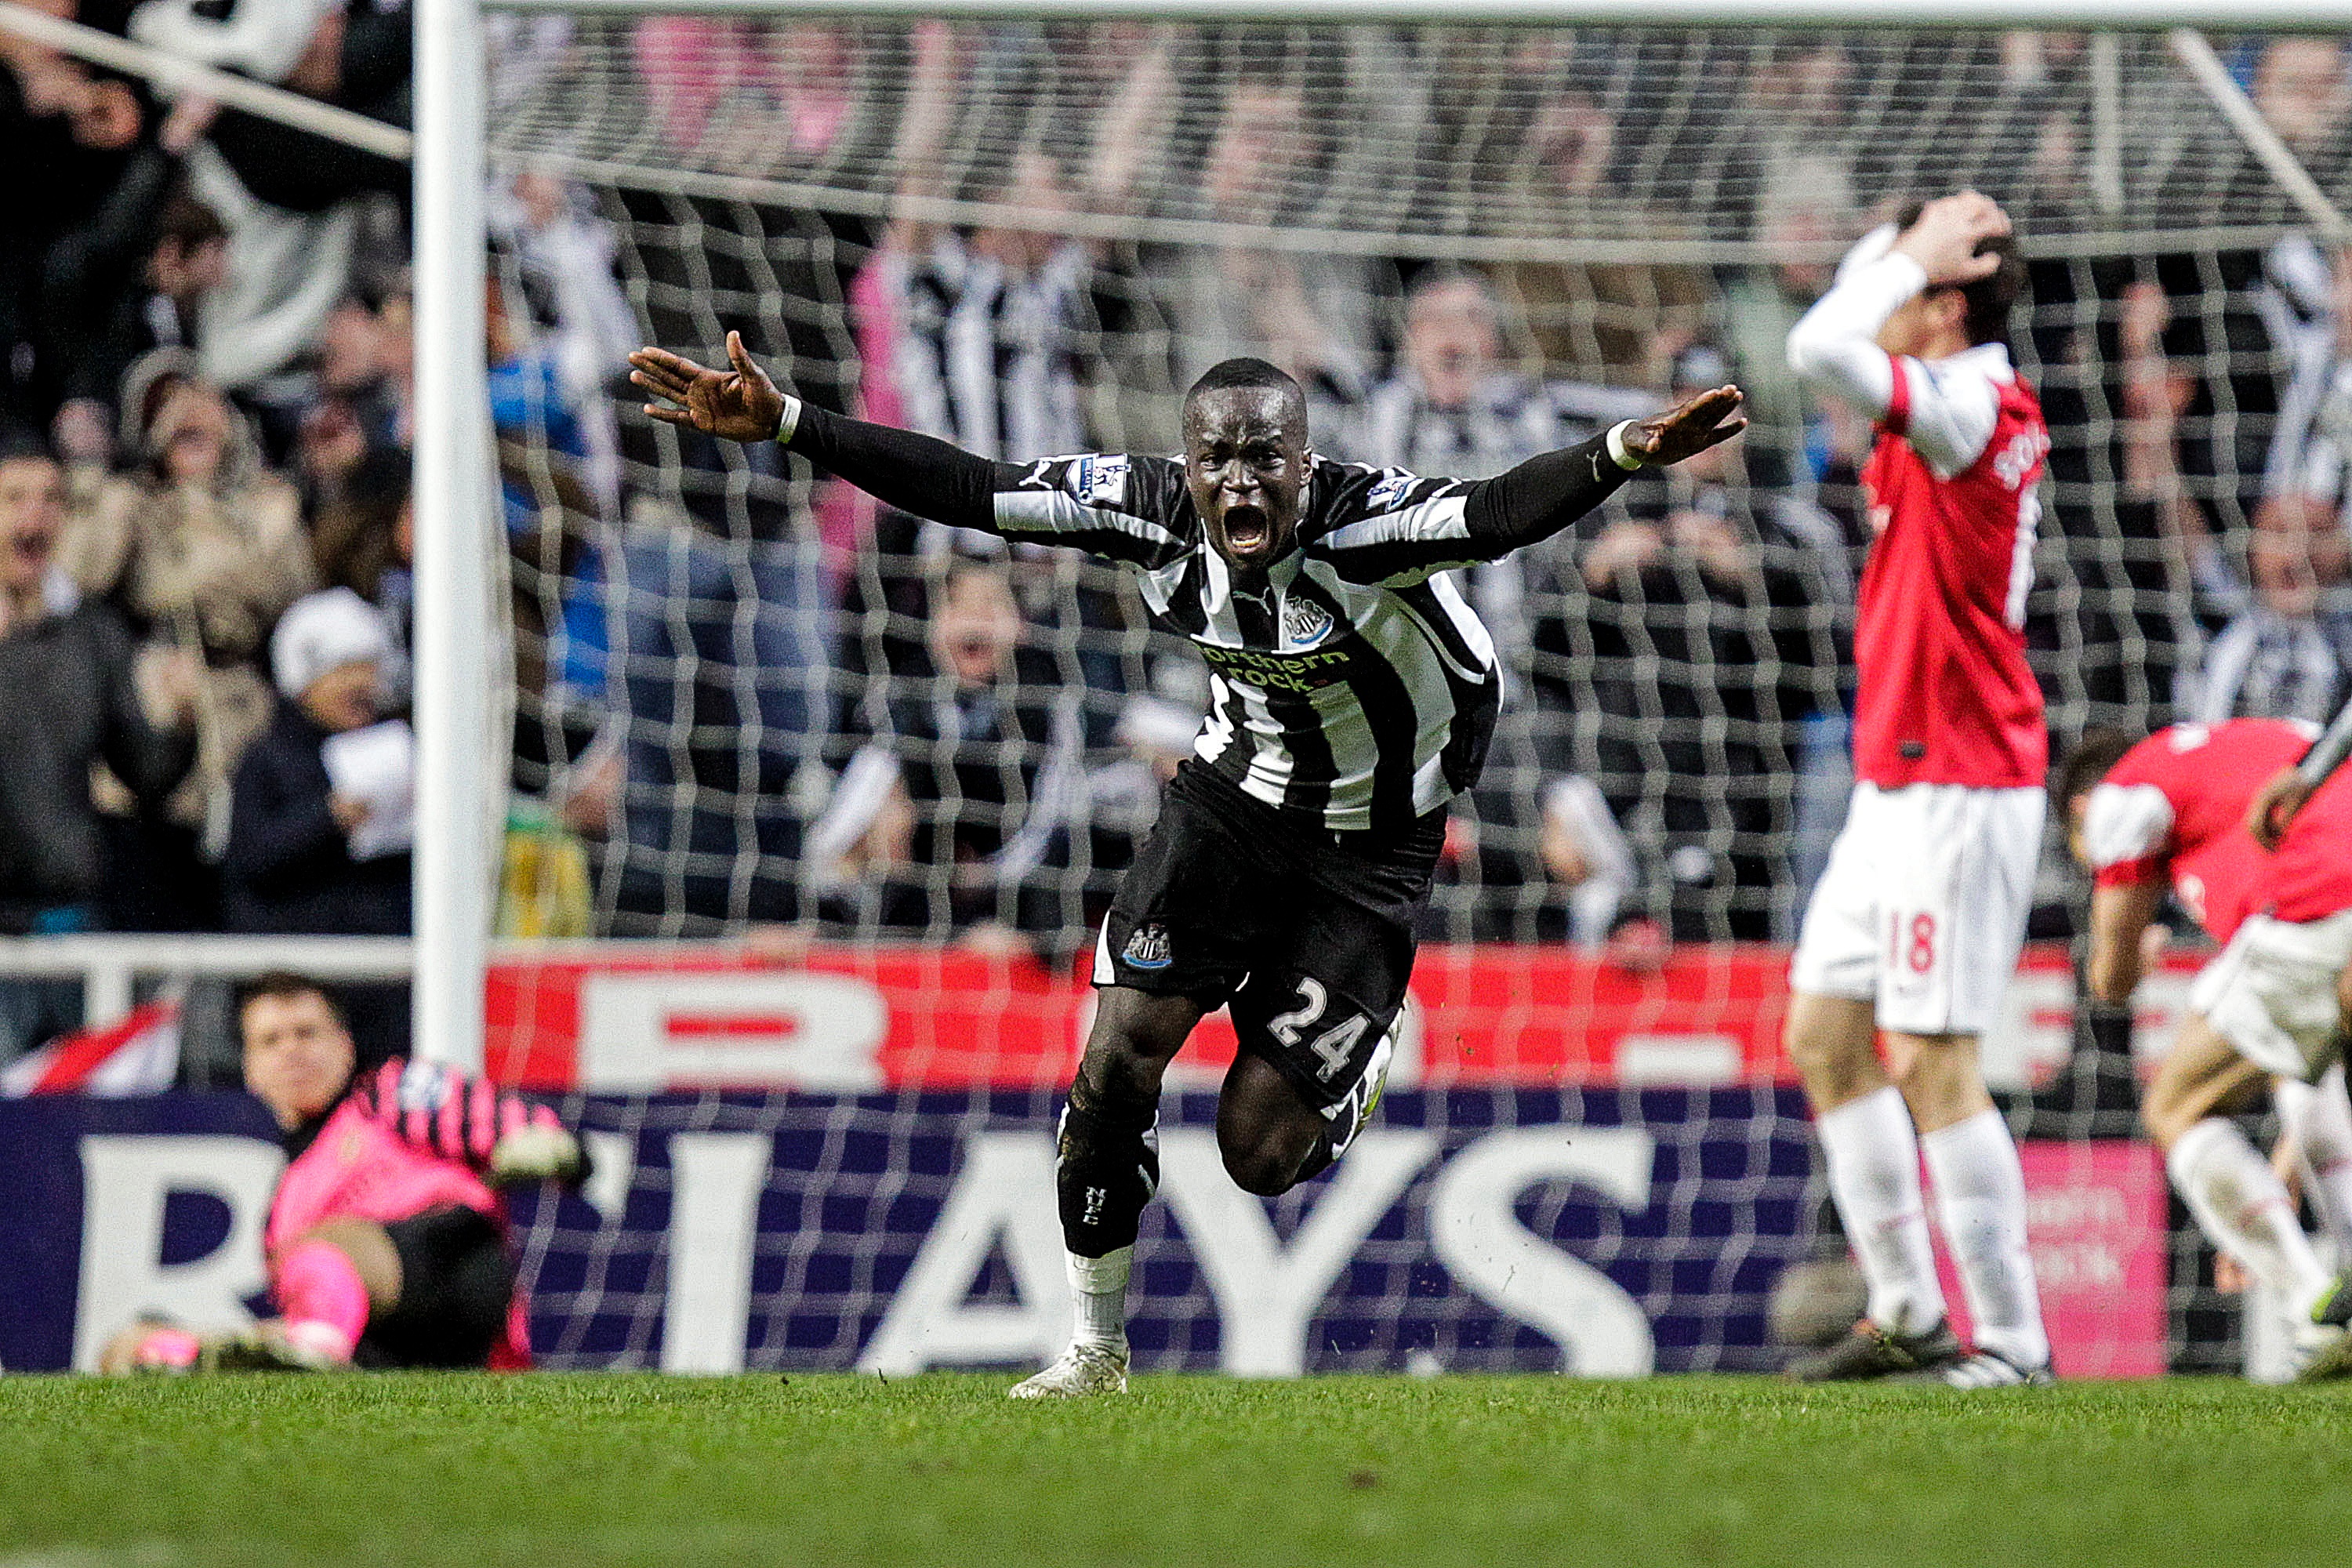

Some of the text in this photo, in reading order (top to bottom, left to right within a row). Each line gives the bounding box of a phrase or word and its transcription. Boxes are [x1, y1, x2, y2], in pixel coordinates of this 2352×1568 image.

[1192, 641, 1350, 674] orthern
[1227, 667, 1314, 691] rock
[1889, 911, 1936, 974] 18
[1267, 977, 1371, 1083] 24
